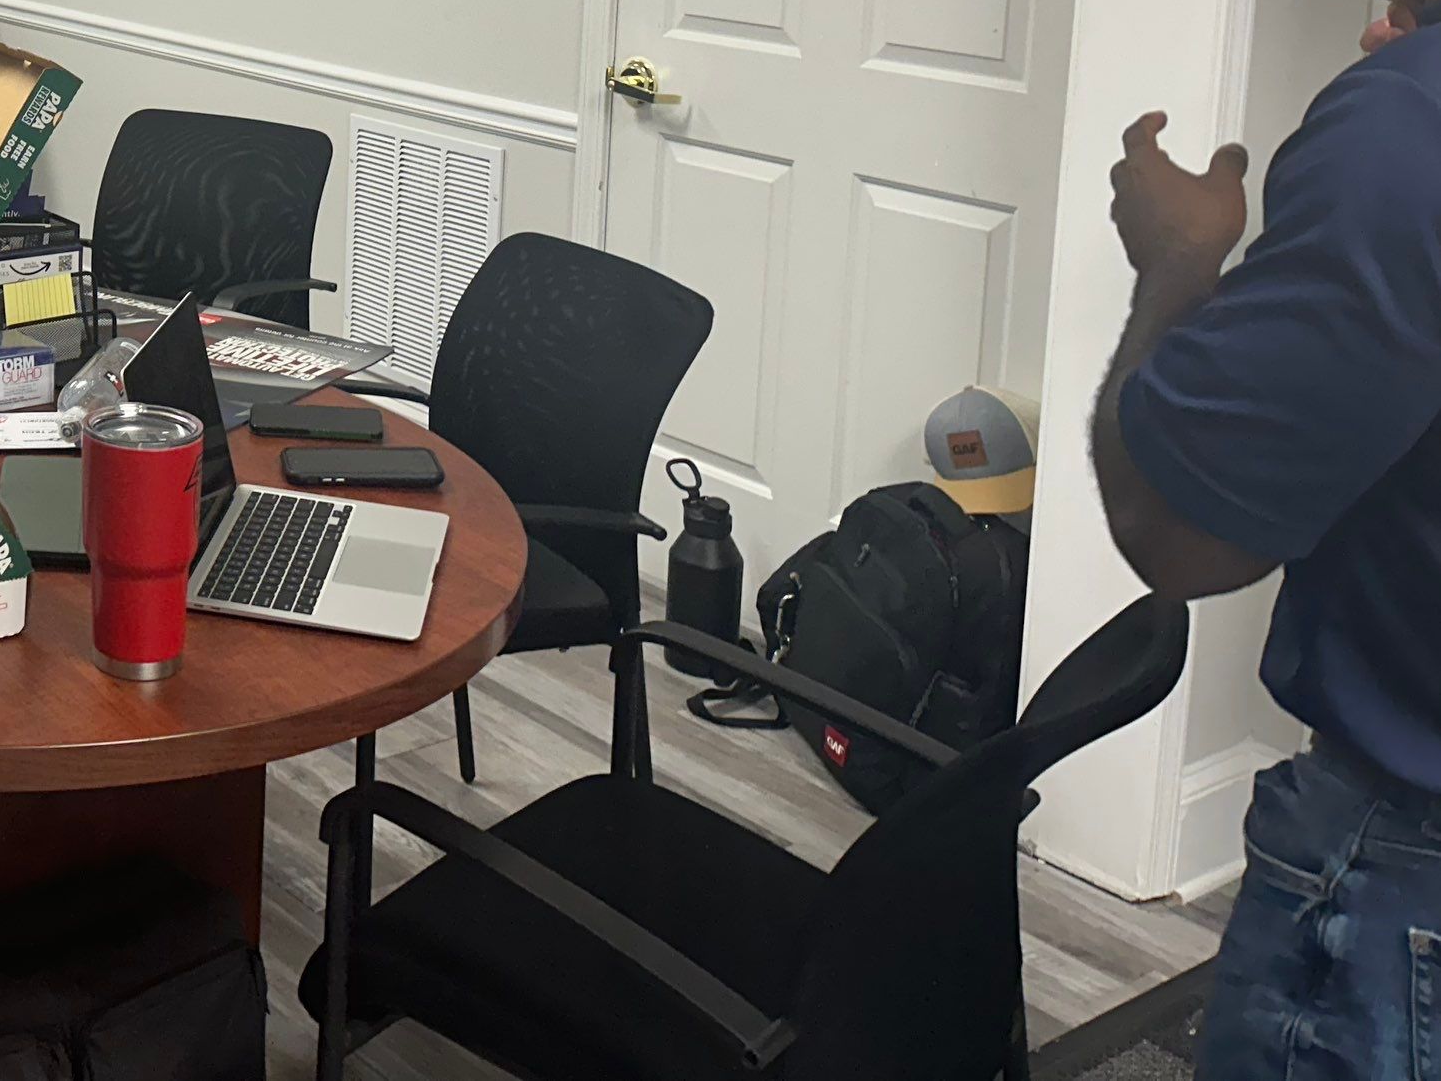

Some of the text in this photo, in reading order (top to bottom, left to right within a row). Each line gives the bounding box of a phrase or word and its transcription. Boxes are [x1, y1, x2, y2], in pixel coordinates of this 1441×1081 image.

[23, 87, 50, 125] REWARDS
[31, 91, 61, 130] PAPA
[0, 133, 19, 159] FOOD
[10, 140, 27, 161] FREE
[17, 145, 36, 170] EARN
[2, 367, 43, 384] GUARD
[952, 442, 979, 456] GAF
